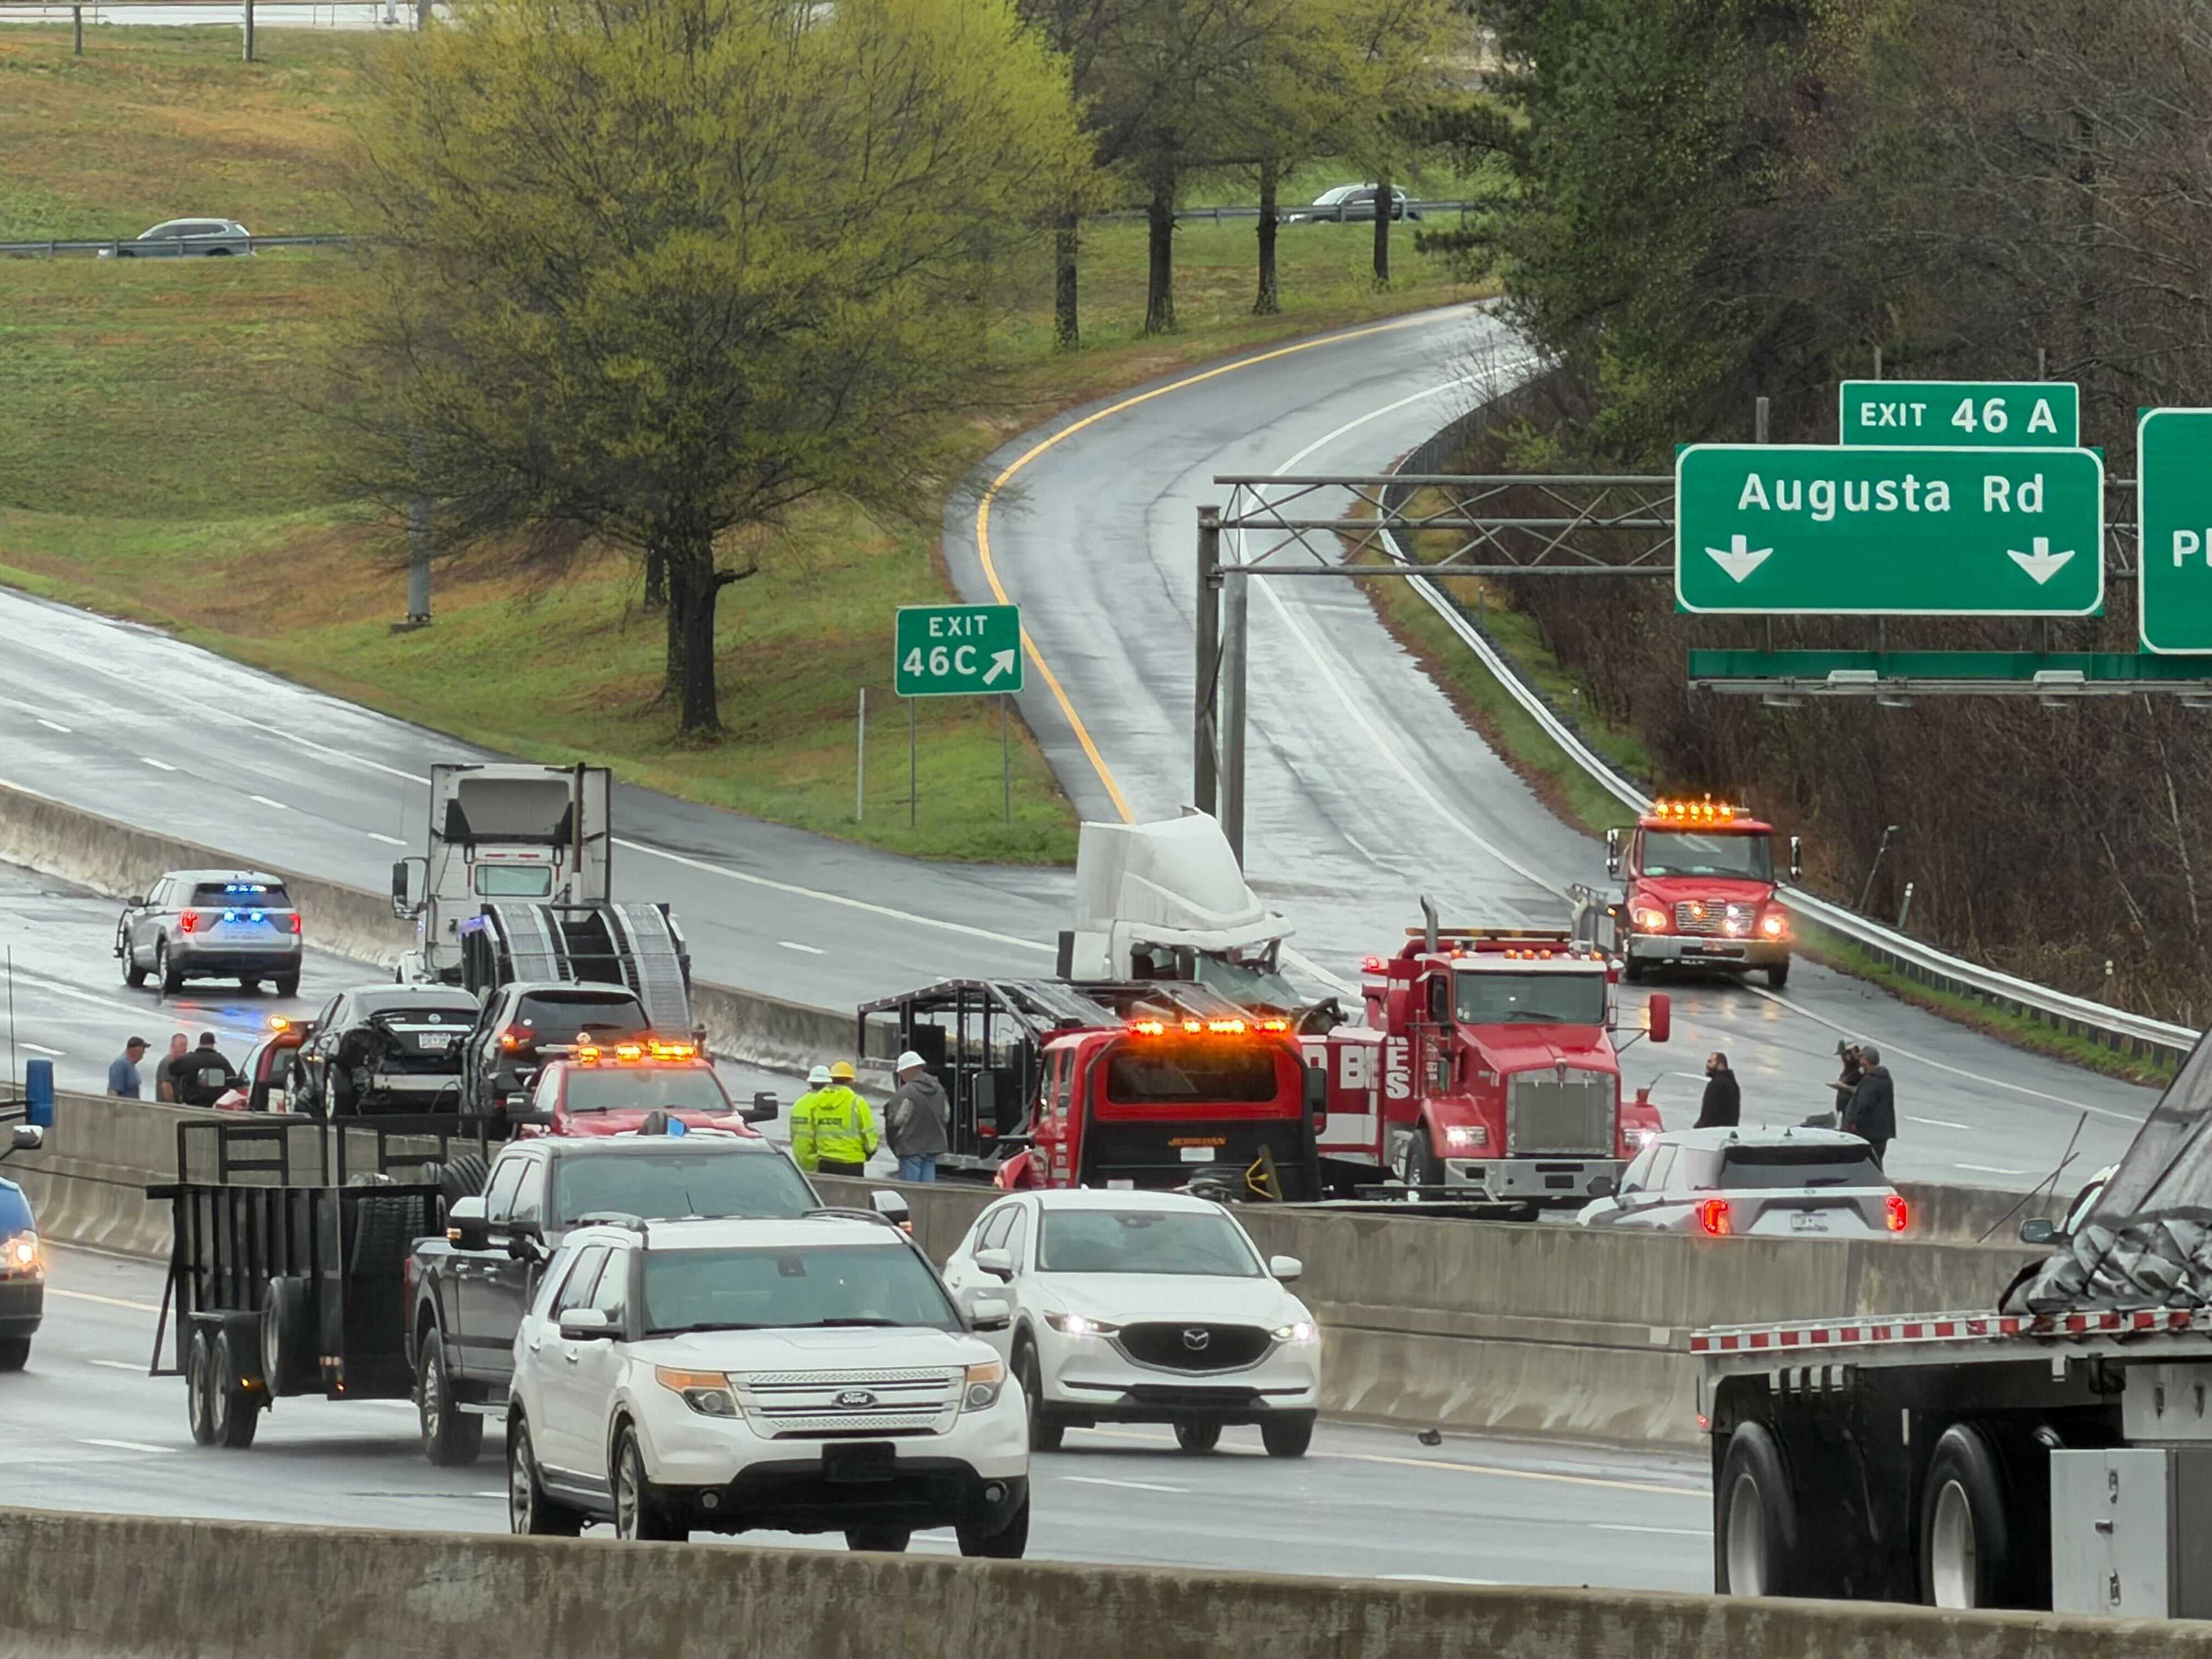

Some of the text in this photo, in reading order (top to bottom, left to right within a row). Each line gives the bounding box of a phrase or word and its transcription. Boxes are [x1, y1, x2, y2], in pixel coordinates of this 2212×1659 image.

[1861, 397, 2057, 434] EXIT 46 A
[1737, 472, 2044, 522] Augusta Rd
[928, 615, 988, 637] EXIT
[902, 644, 977, 677] 46C
